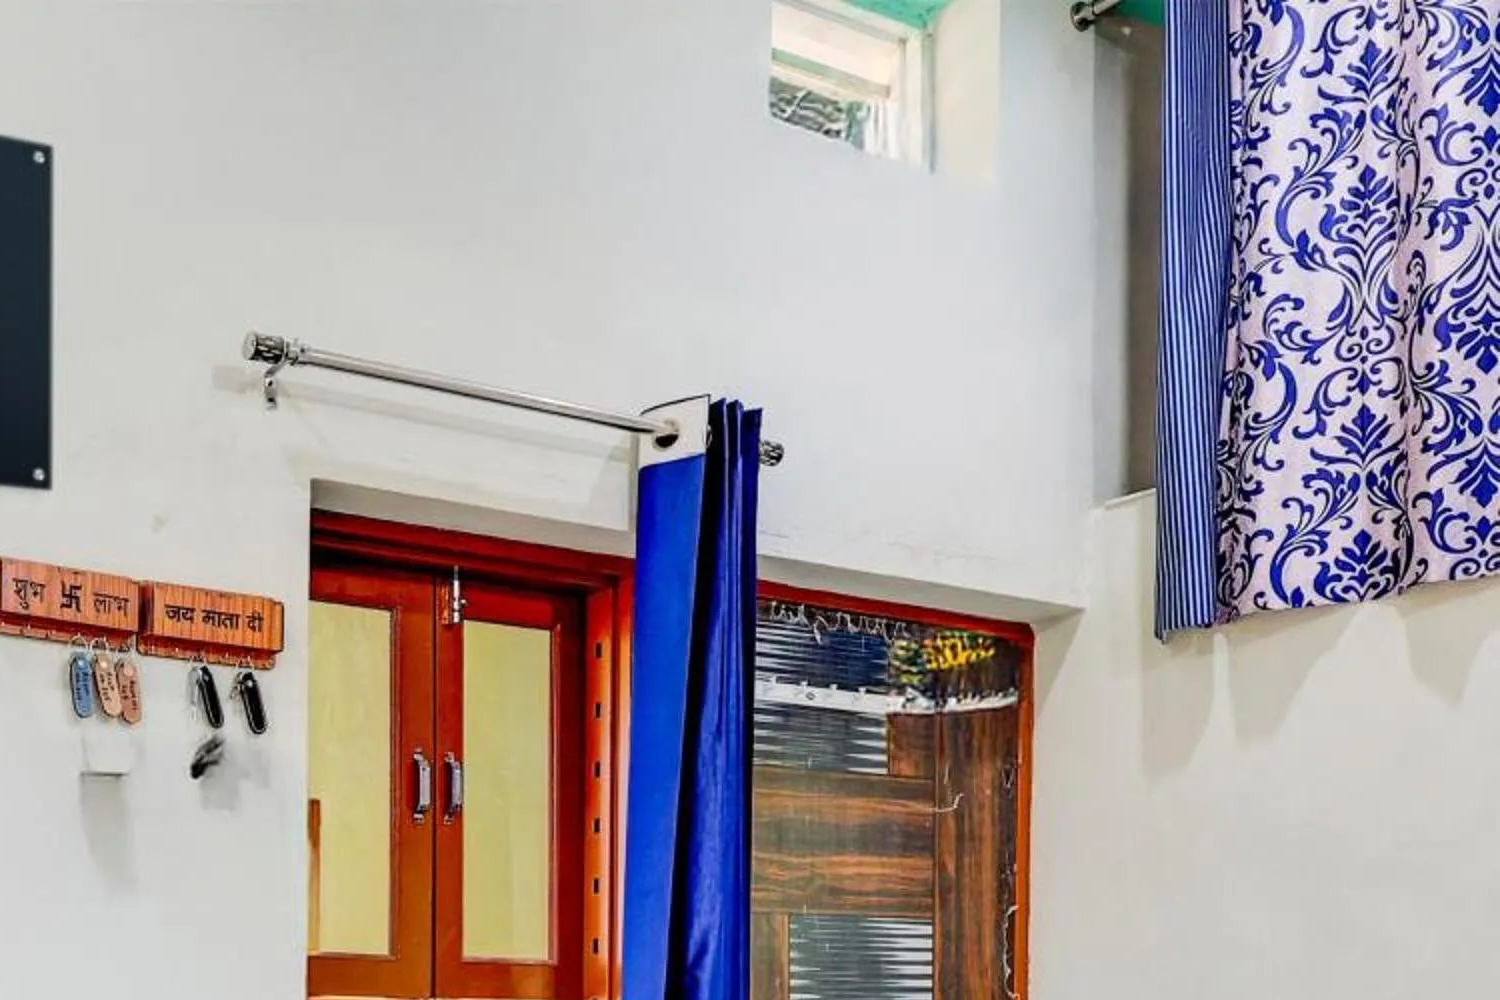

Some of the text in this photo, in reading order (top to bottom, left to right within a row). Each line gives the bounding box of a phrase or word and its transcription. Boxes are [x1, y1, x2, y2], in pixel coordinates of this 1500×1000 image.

[12, 577, 129, 617] शुभ लाभ
[164, 603, 264, 633] जय माता दी
